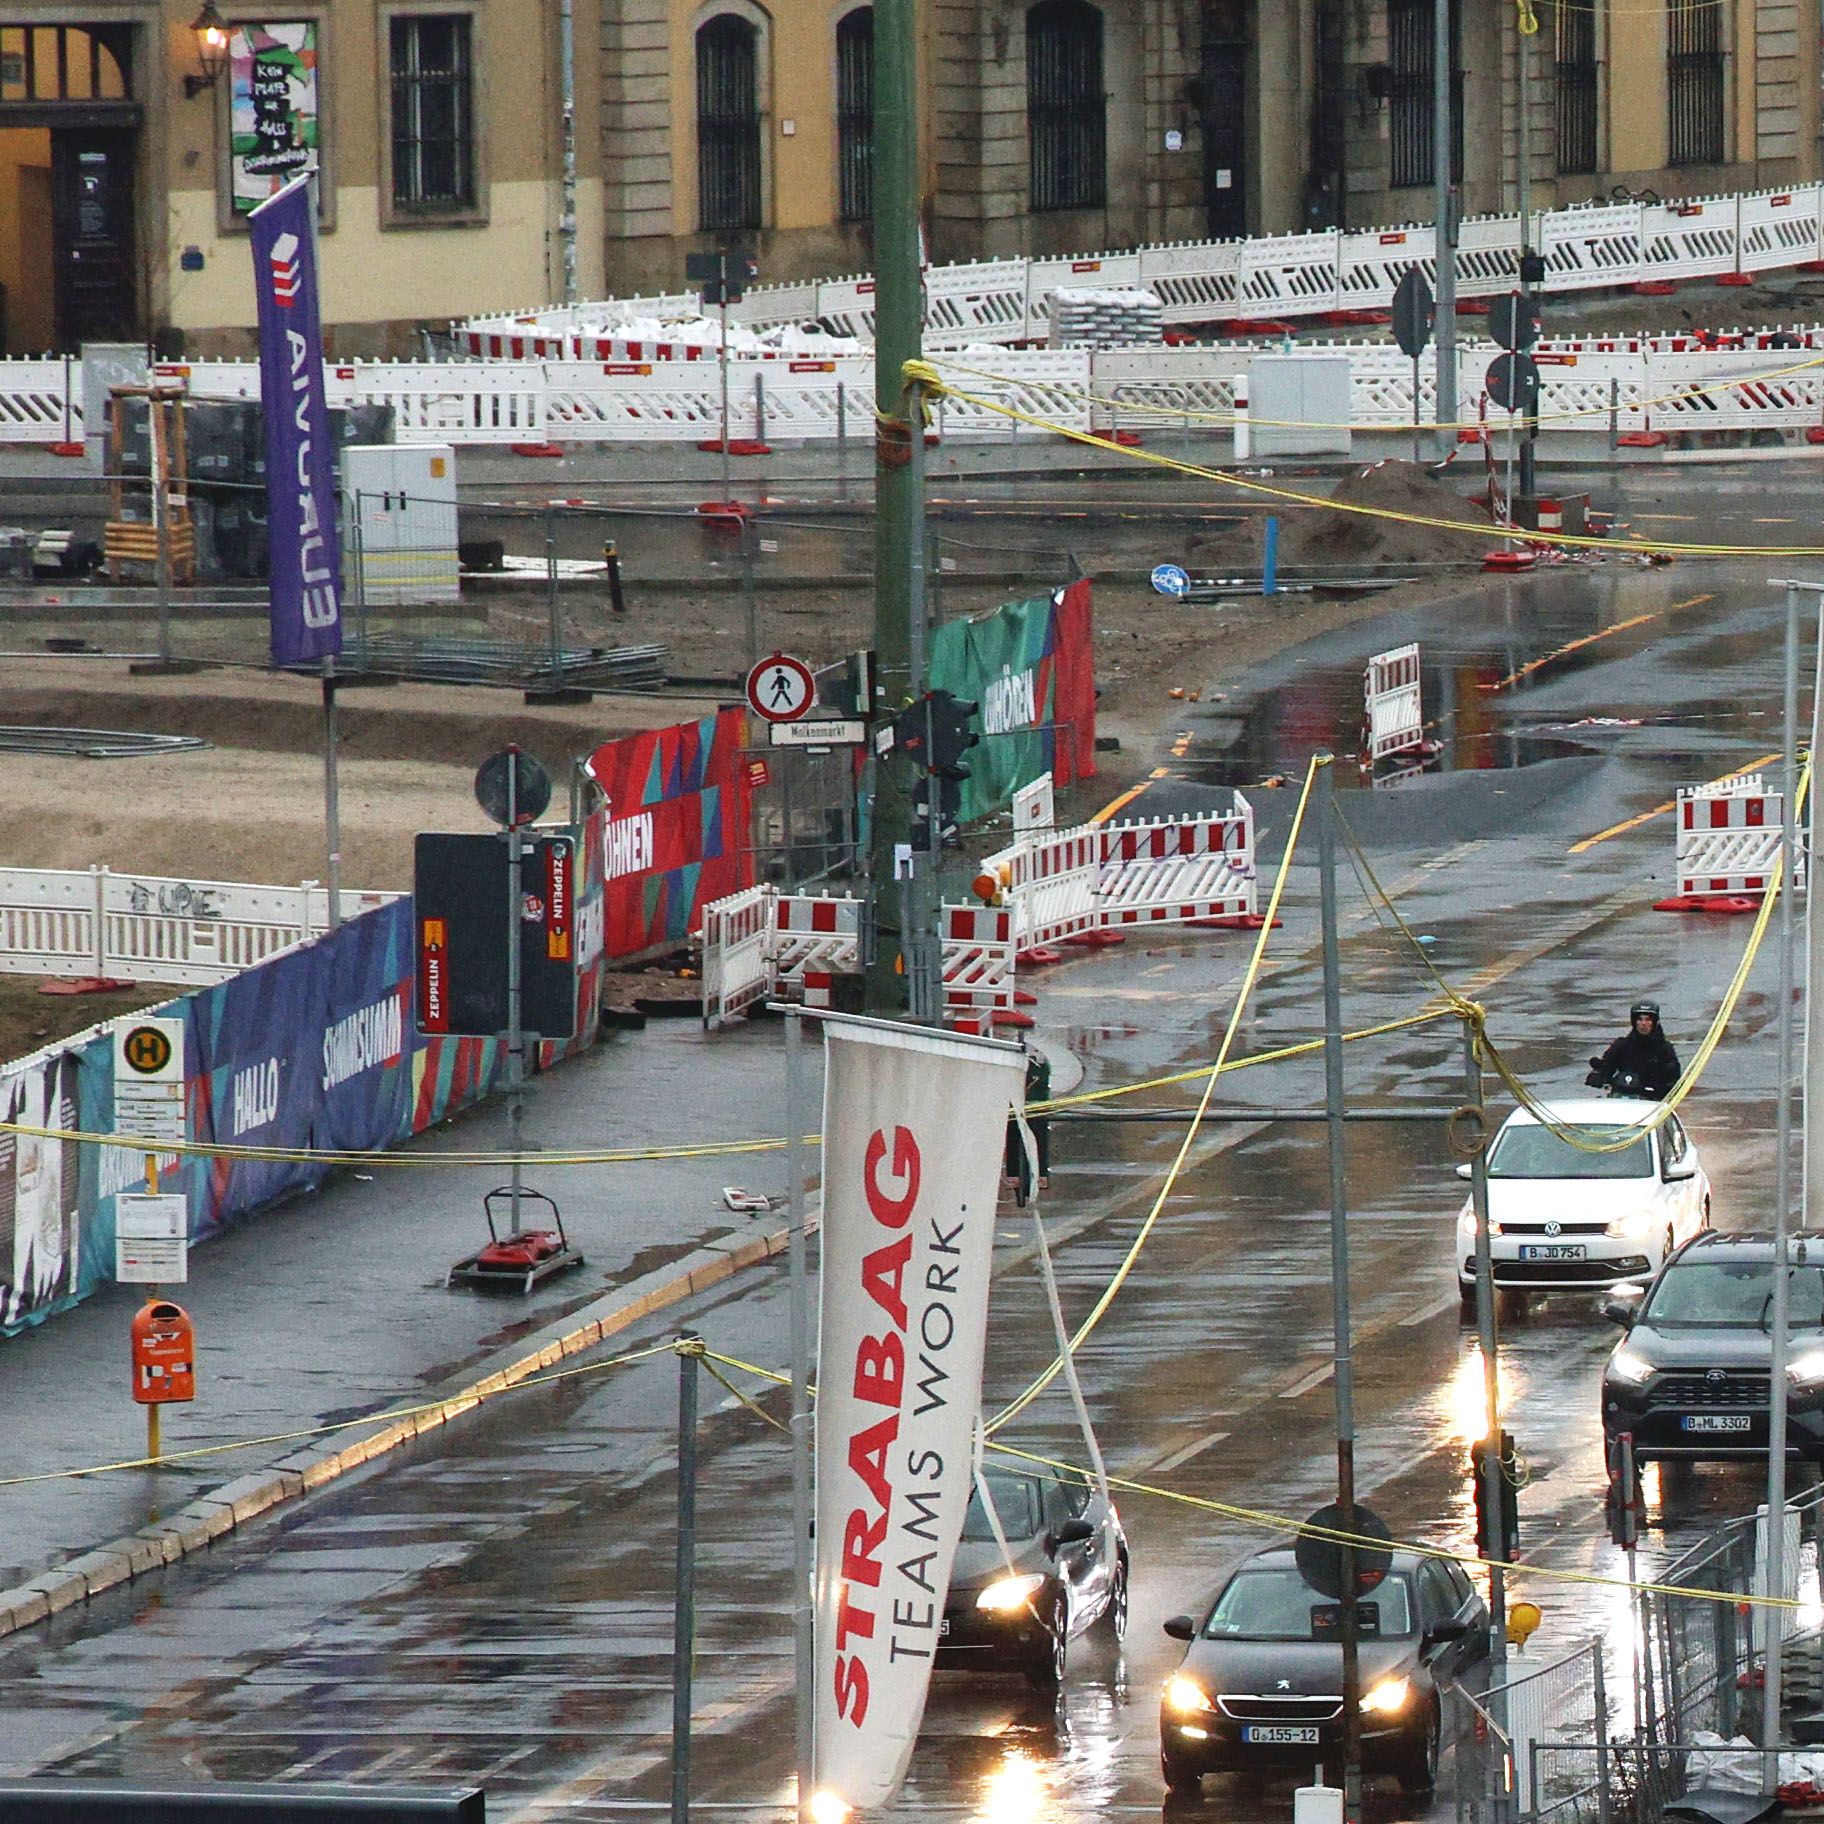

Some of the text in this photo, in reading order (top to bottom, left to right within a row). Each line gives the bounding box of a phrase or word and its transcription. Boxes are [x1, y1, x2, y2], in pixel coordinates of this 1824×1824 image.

[553, 858, 563, 920] ZEPPELIN
[430, 959, 440, 1020] ZEPPELIN
[134, 1037, 159, 1063] H
[233, 1056, 279, 1137] HALLO
[1528, 1246, 1537, 1259] B
[1559, 1246, 1581, 1259] 754
[834, 1123, 922, 1730] STRABAG
[1686, 1416, 1696, 1430] B
[1720, 1416, 1750, 1430] 3302
[889, 1447, 946, 1663] TEAMS
[1268, 1728, 1317, 1743] 155-12
